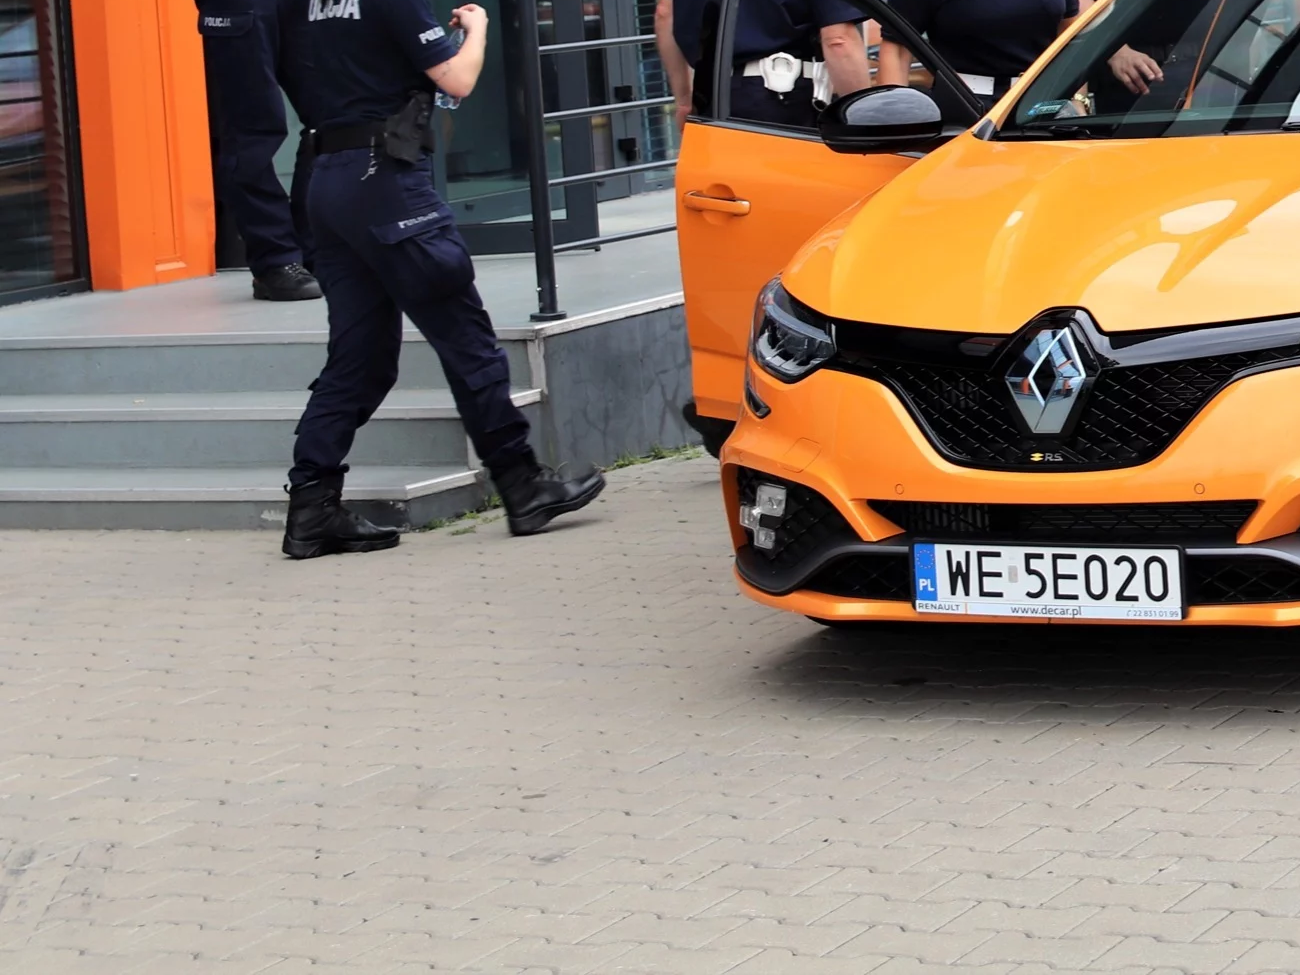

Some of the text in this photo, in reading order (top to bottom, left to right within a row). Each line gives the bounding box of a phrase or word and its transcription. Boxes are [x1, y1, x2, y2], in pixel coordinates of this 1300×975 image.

[918, 578, 936, 592] PL
[946, 550, 1170, 603] WE 5E020
[918, 602, 961, 612] RENAULT
[1010, 605, 1083, 619] www.decar.pl
